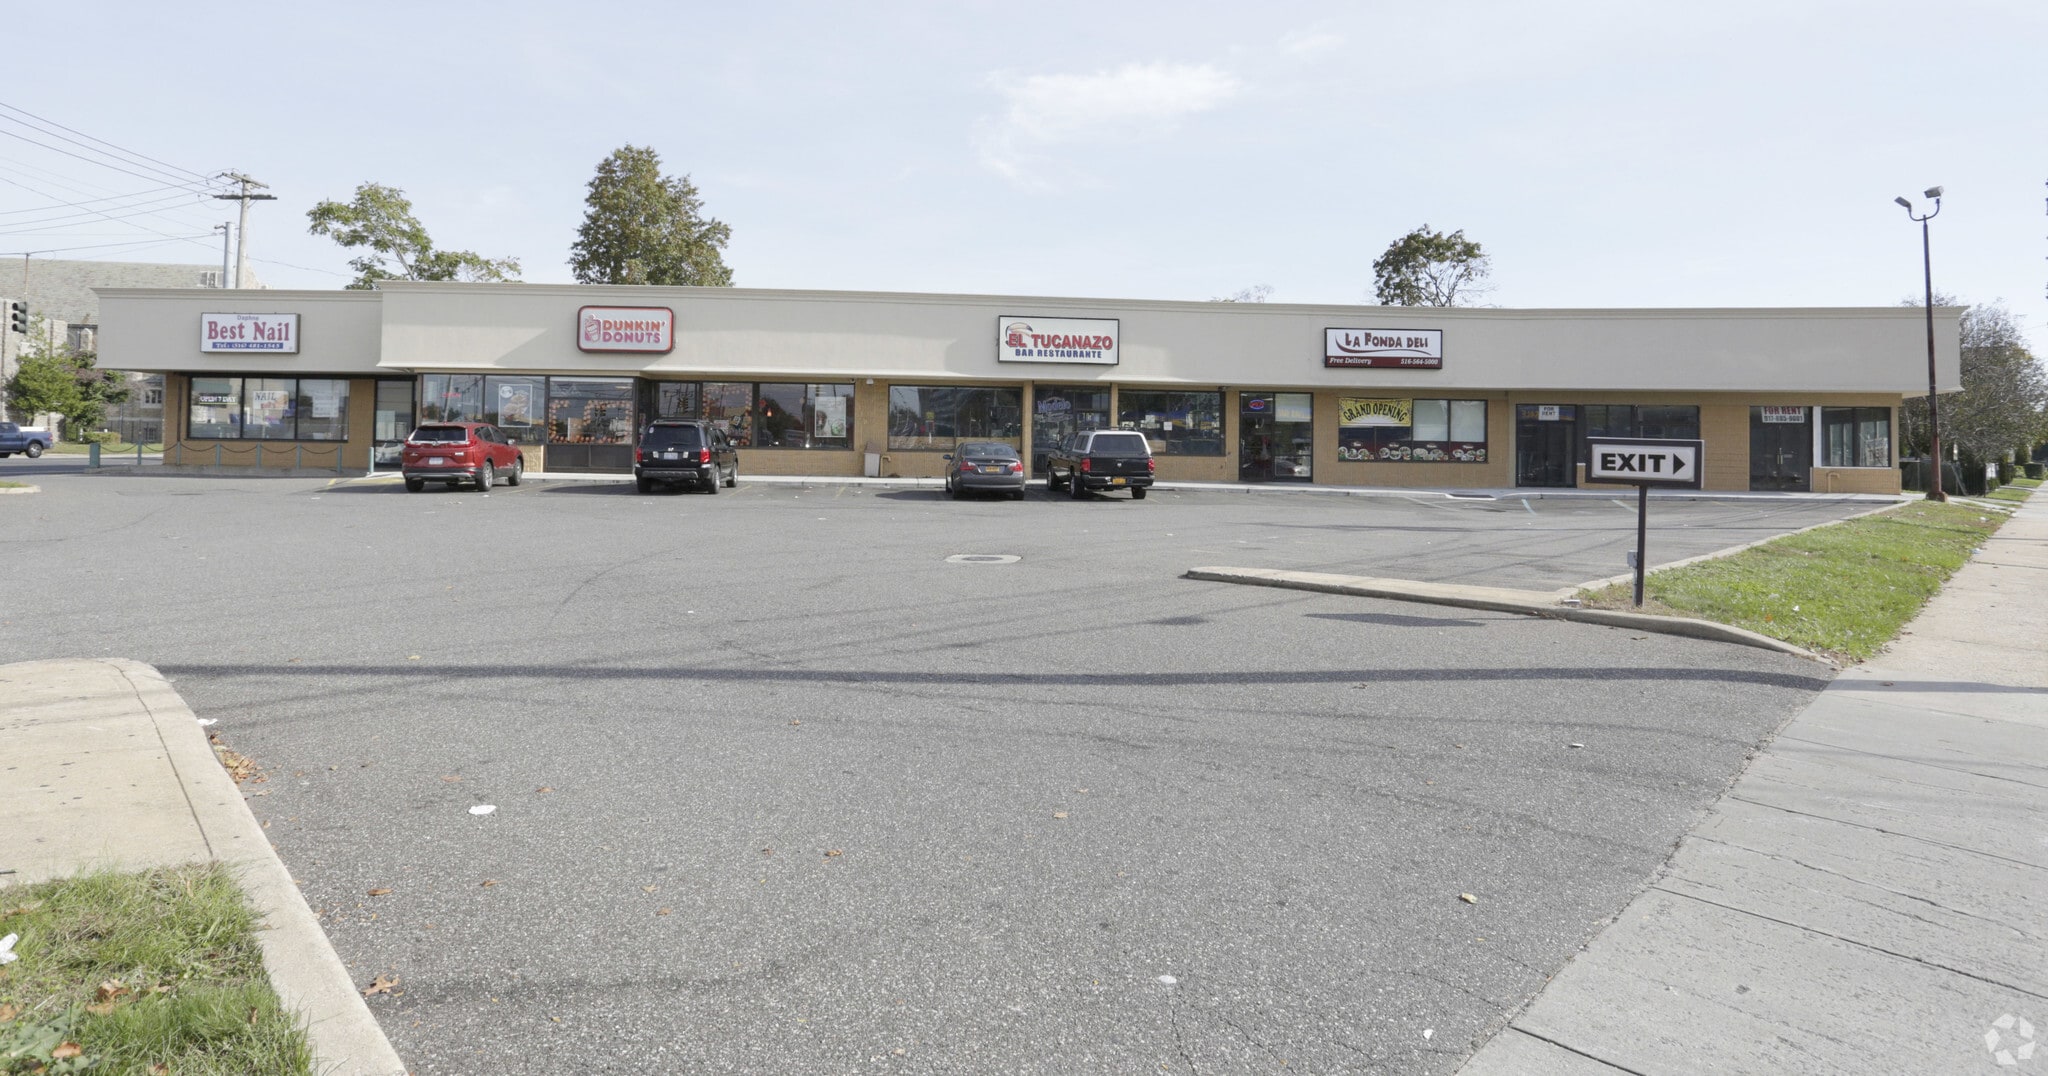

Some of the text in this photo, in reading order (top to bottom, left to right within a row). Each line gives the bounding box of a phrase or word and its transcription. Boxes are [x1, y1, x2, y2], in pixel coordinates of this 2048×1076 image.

[207, 320, 290, 341] Best Nail
[602, 319, 665, 332] DUNKIN'
[602, 331, 661, 343] DONUTS
[1007, 333, 1114, 350] EL TUCANAZO
[1345, 331, 1428, 348] LA FONDA DELI
[1015, 349, 1102, 359] BAR RESTAURANTE
[1345, 357, 1372, 365] Delivery
[1343, 403, 1408, 422] GRAND OPENING
[1764, 406, 1802, 415] FOR RENT
[1600, 453, 1666, 473] EXIT
